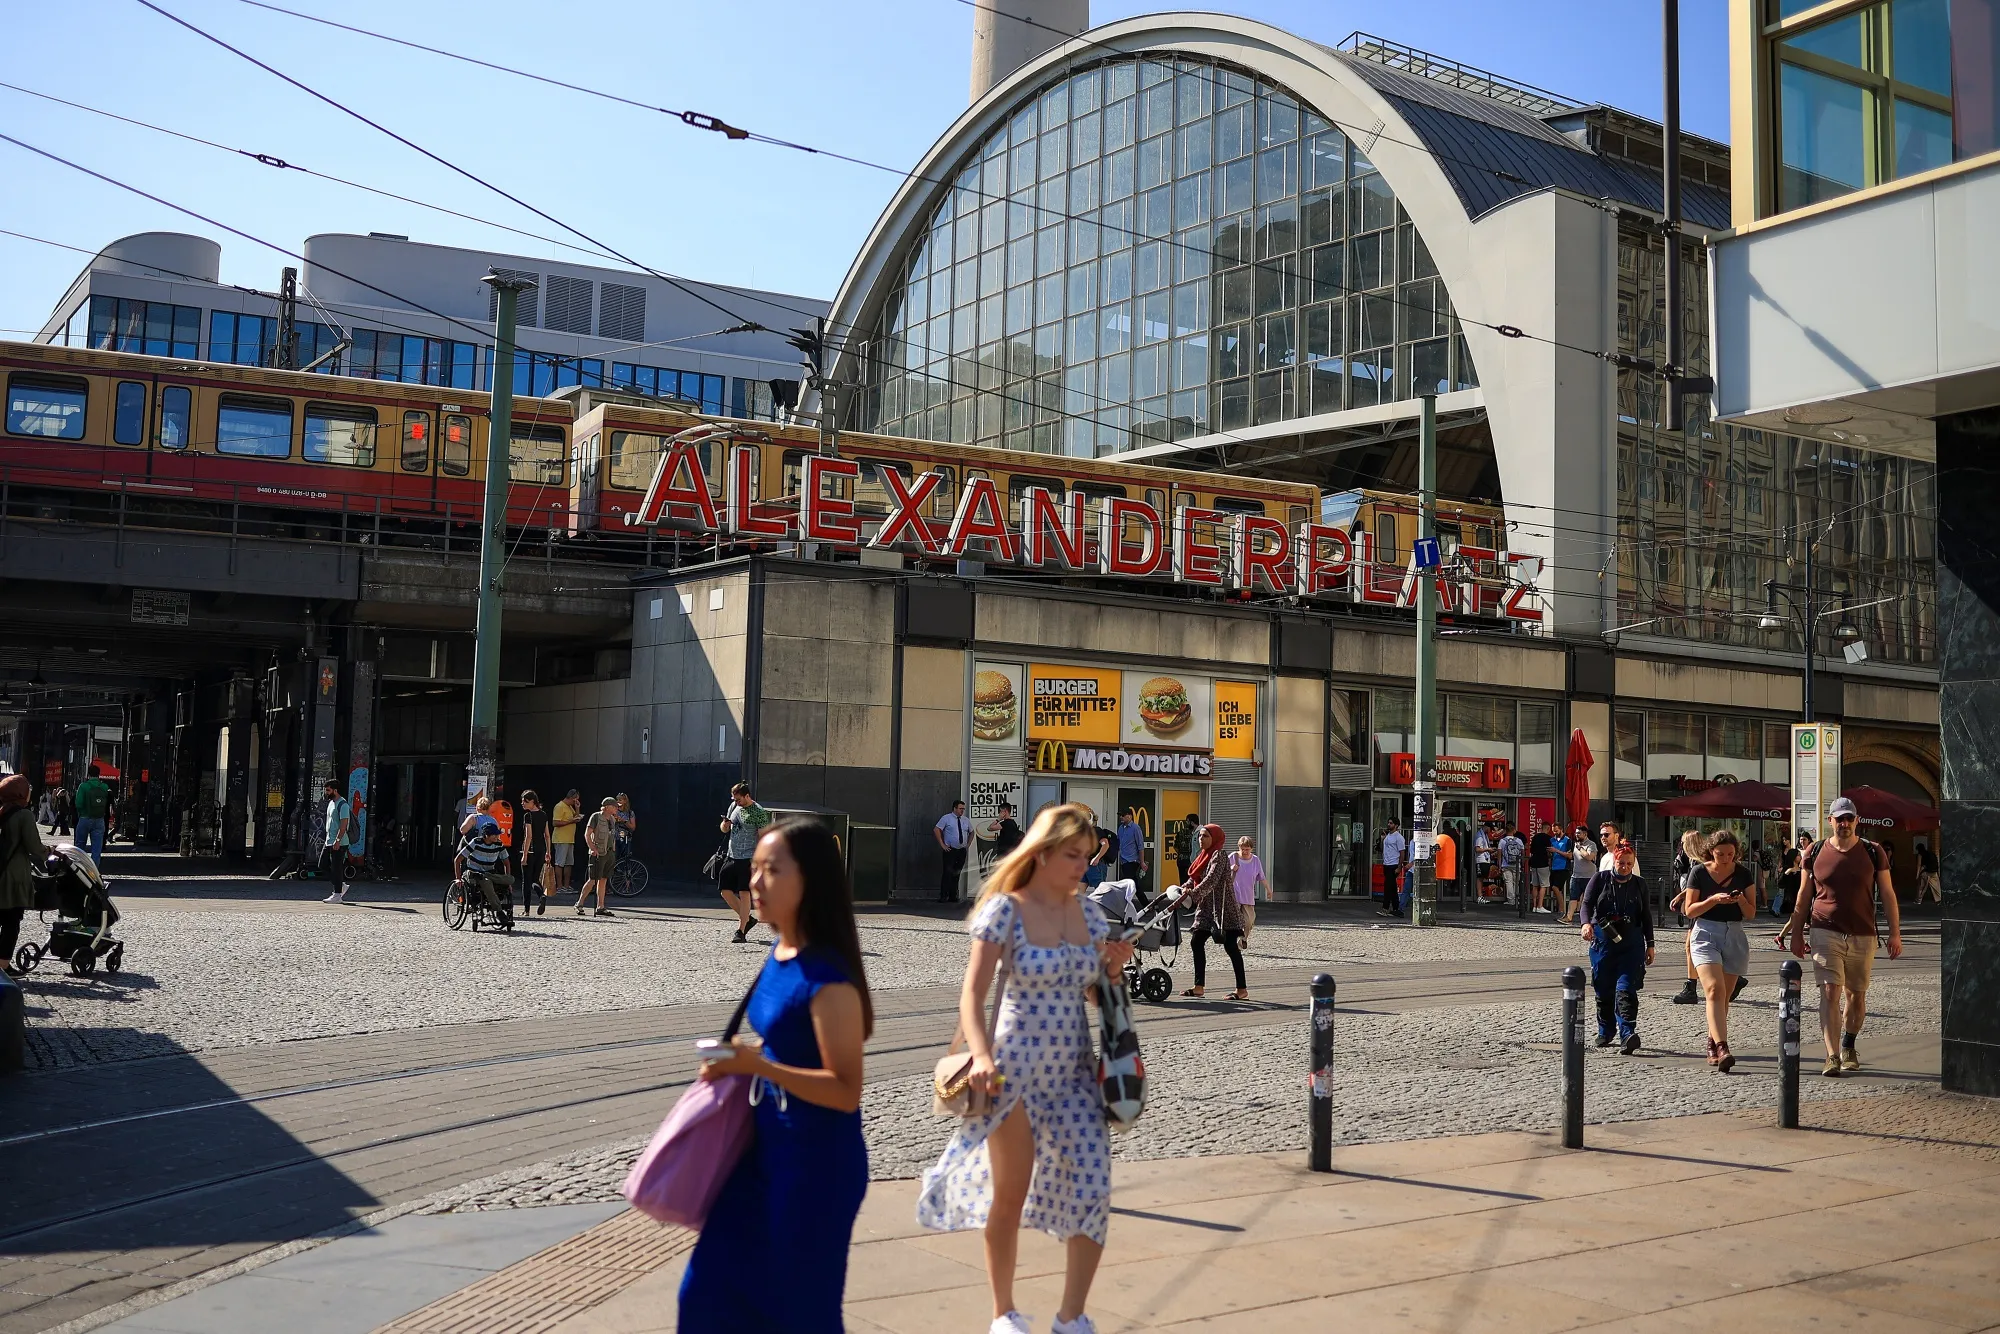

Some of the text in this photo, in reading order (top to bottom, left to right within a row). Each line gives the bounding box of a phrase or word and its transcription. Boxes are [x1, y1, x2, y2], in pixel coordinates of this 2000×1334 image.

[634, 440, 1545, 622] ALEXANDERPLATZ
[1034, 679, 1097, 695] BURGER
[1064, 697, 1117, 711] MITTE?
[1218, 701, 1239, 713] ICH
[1034, 711, 1081, 727] BITTE!
[1218, 713, 1252, 725] LIEBE
[1219, 727, 1238, 739] ES!
[1073, 748, 1212, 775] McDonald's
[1435, 759, 1485, 773] RRYWURST
[1437, 772, 1471, 783] EXPRESS
[970, 782, 1021, 794] SCHLAF-
[970, 793, 1007, 805] LOS IN
[971, 805, 1017, 817] BERL:
[1742, 808, 1770, 819] Kamps
